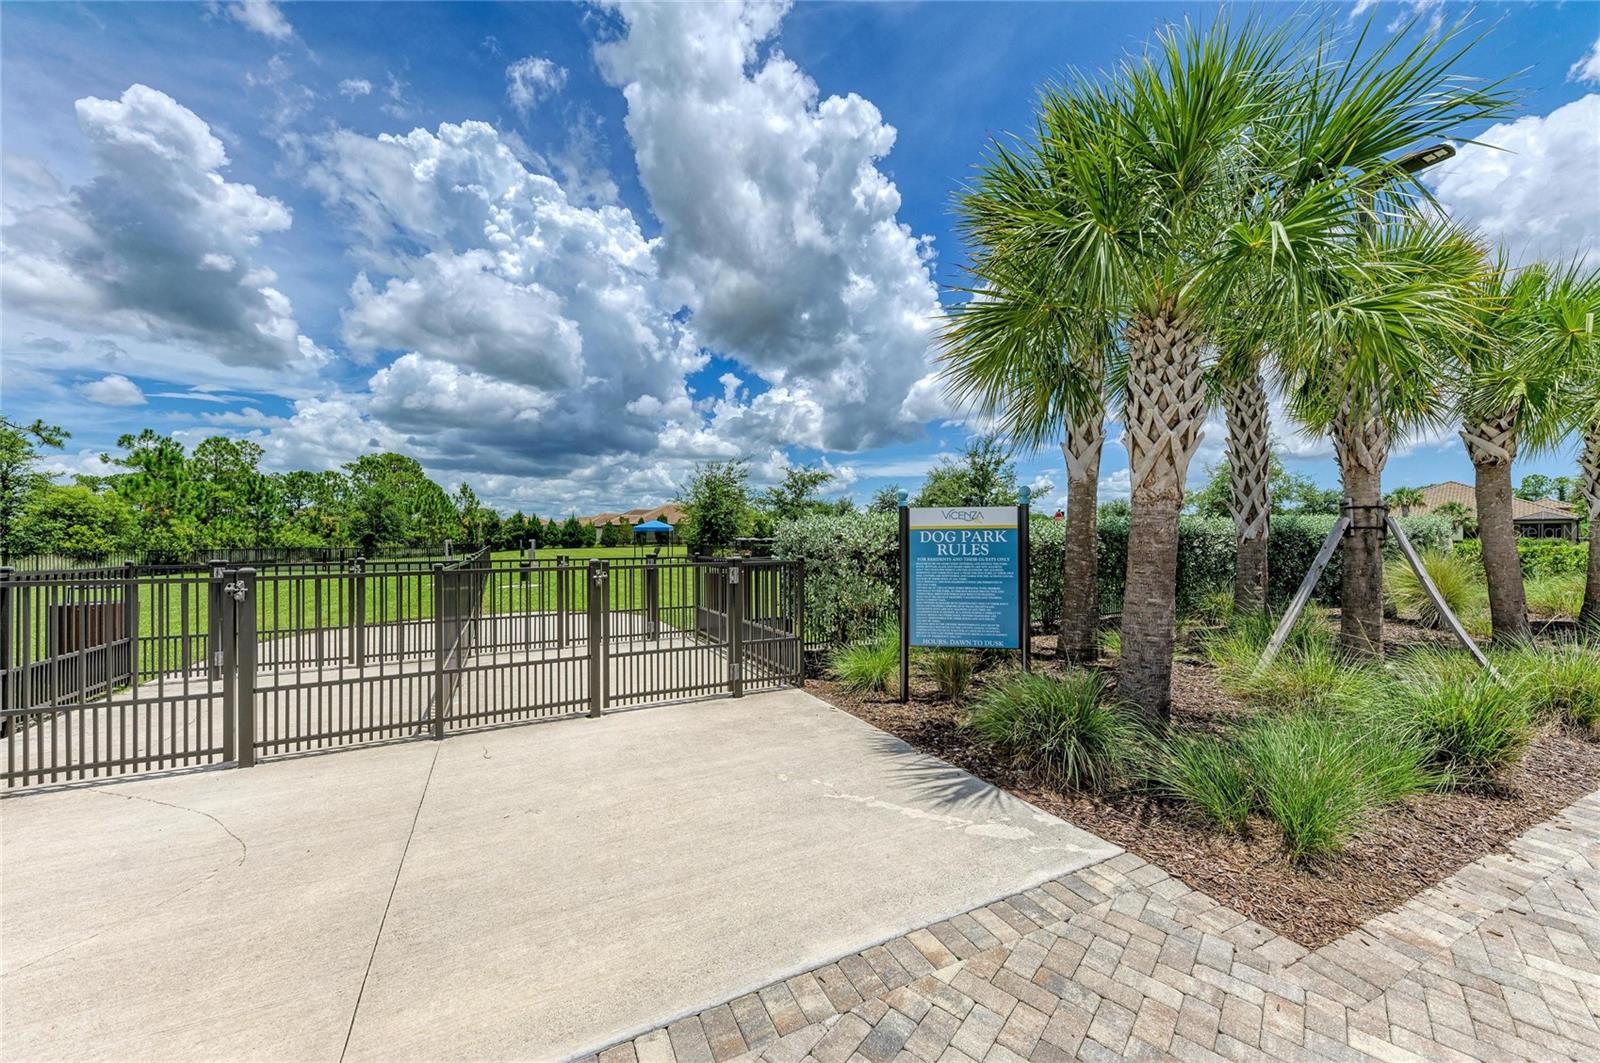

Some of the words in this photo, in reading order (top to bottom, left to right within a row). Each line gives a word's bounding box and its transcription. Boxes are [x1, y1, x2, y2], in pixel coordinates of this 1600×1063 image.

[920, 530, 956, 543] DOG
[961, 530, 1008, 543] PARK
[937, 543, 989, 556] RULES
[950, 639, 972, 647] DAWN
